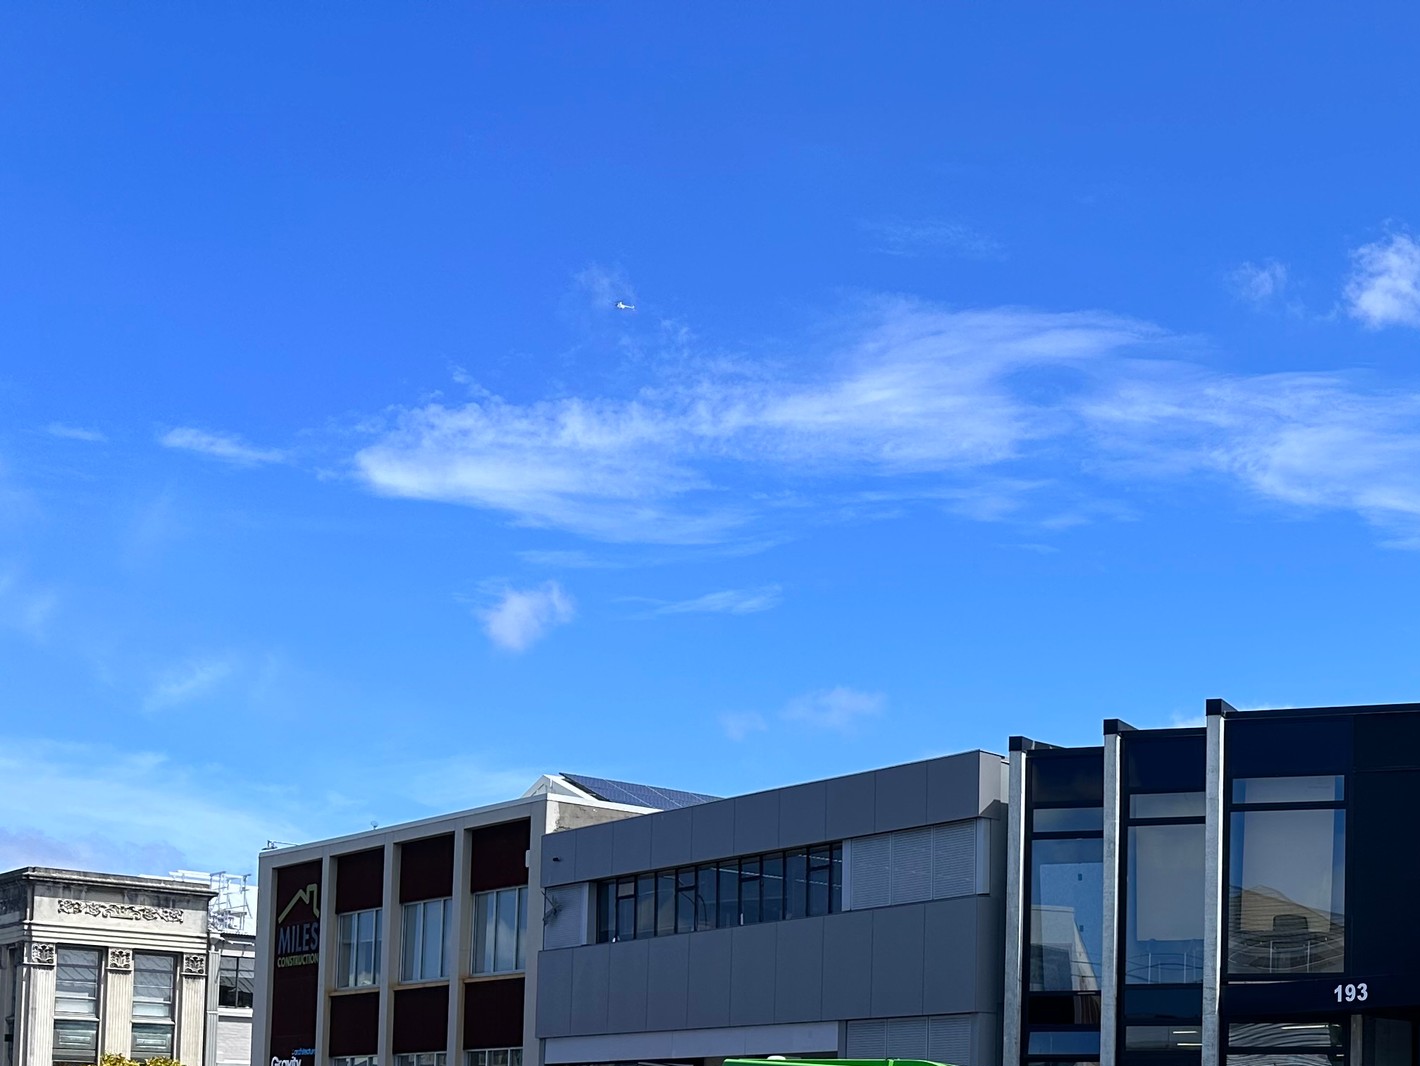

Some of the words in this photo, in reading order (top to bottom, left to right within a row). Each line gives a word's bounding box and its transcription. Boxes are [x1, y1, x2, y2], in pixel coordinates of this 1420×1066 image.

[278, 922, 319, 954] MILES
[277, 953, 320, 968] CONSTRUCTION
[1334, 983, 1368, 1002] 193
